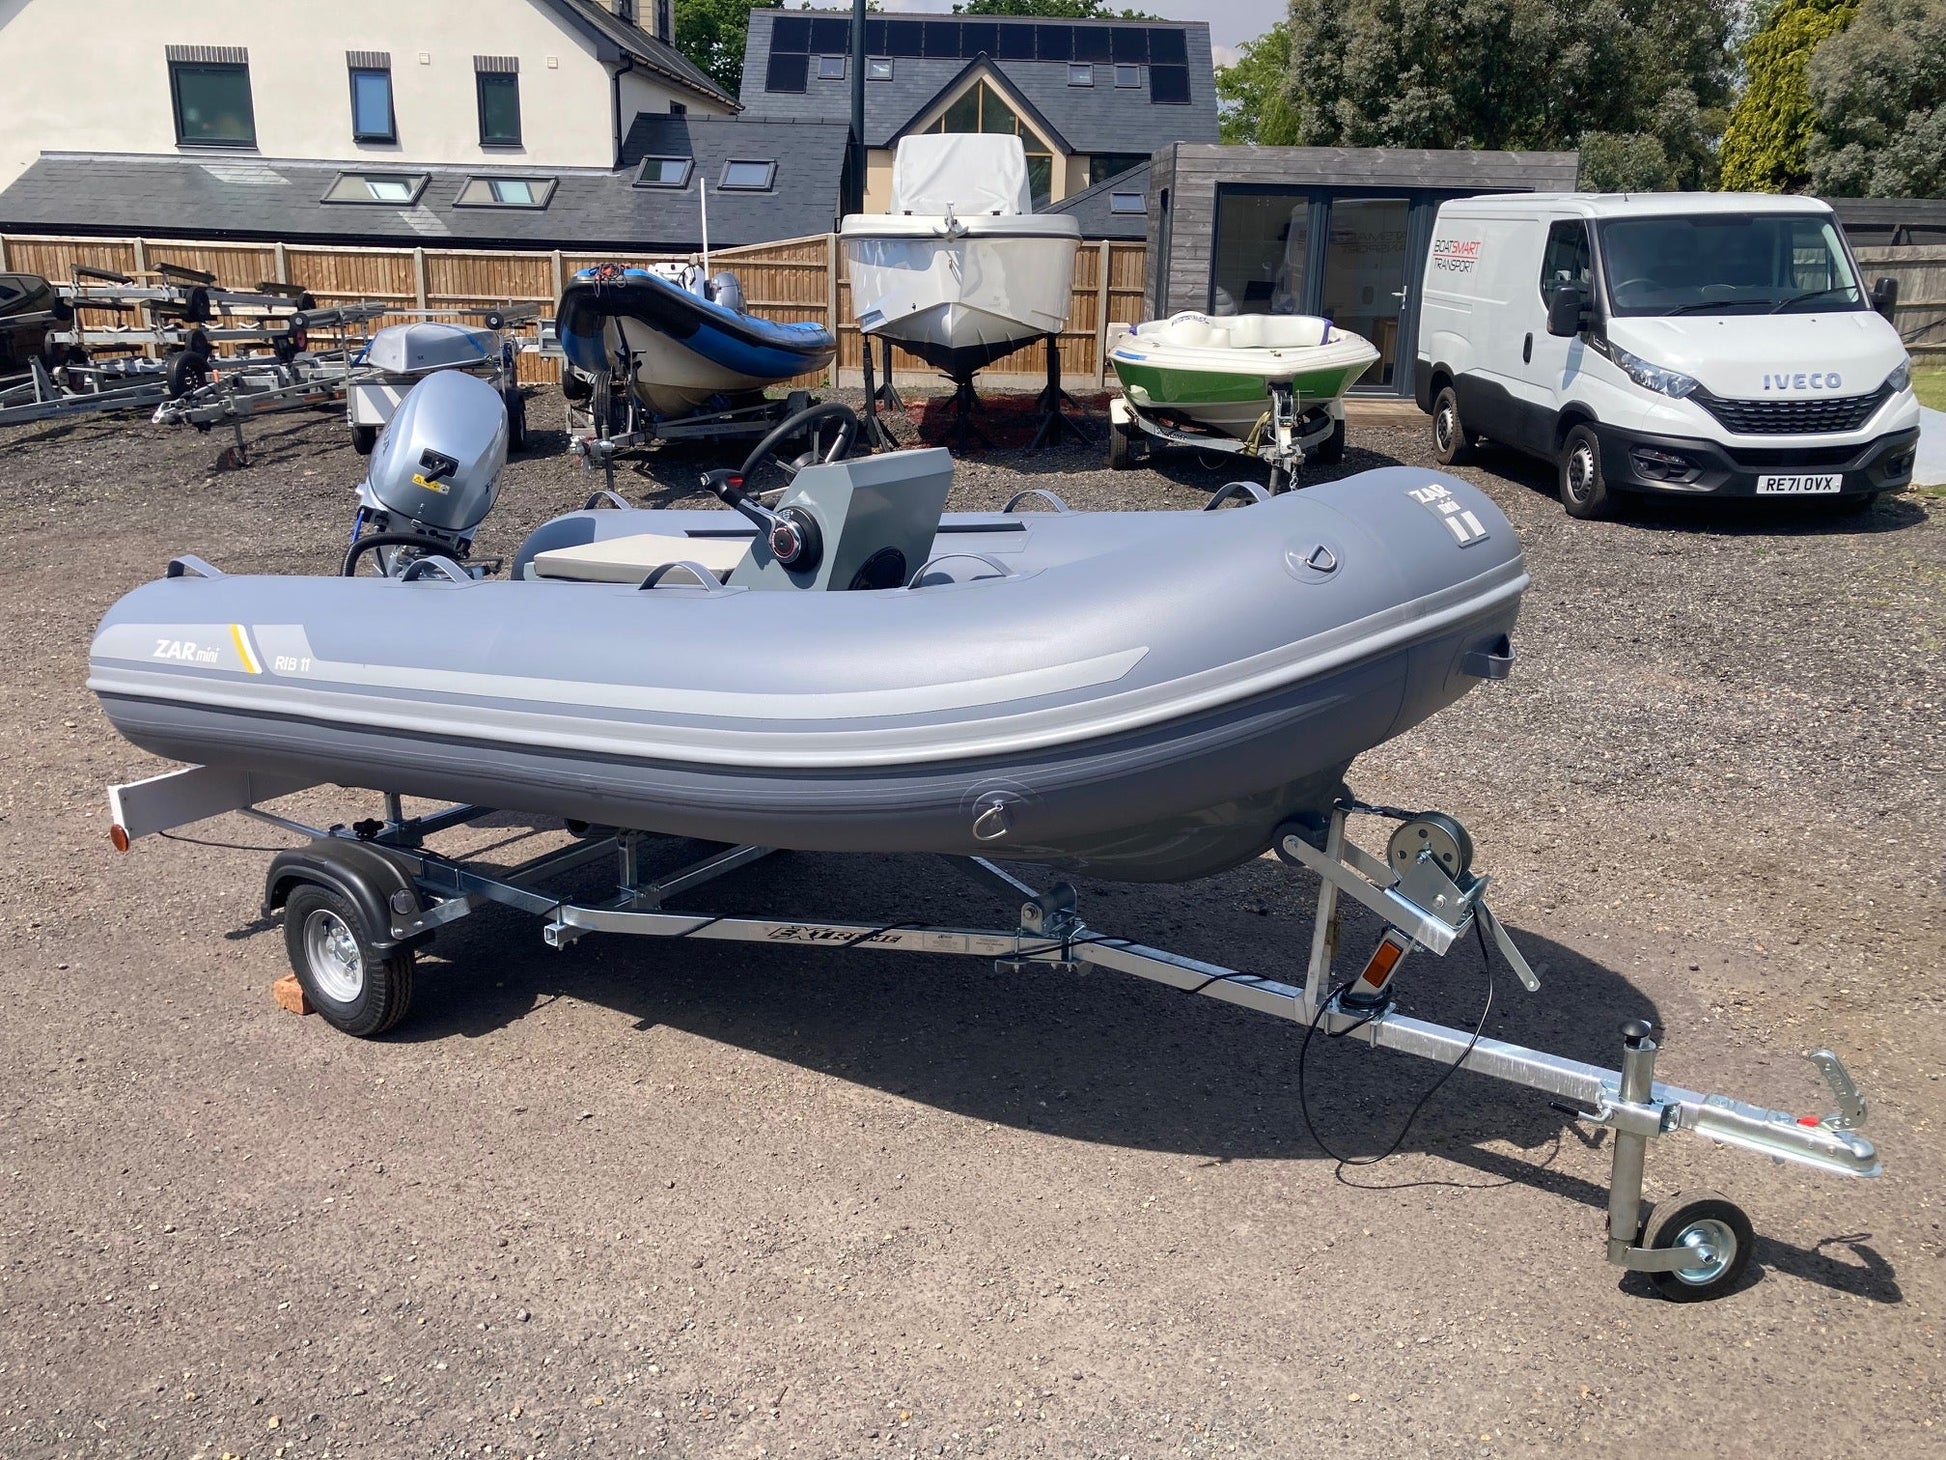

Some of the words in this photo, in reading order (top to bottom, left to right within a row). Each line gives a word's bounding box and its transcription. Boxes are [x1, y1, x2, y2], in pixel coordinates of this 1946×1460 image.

[1434, 240, 1480, 254] BOATSMART
[1434, 258, 1474, 272] TRANSPORT
[1763, 372, 1842, 390] IVECO
[1766, 478, 1801, 491] RE71
[1804, 476, 1833, 490] OVX
[1408, 484, 1453, 503] ZAR
[1437, 496, 1461, 515] mini
[153, 639, 197, 661] ZAR
[196, 647, 220, 663] mini
[274, 655, 297, 671] RIB
[300, 657, 311, 671] 11
[767, 925, 902, 944] EXTRME
